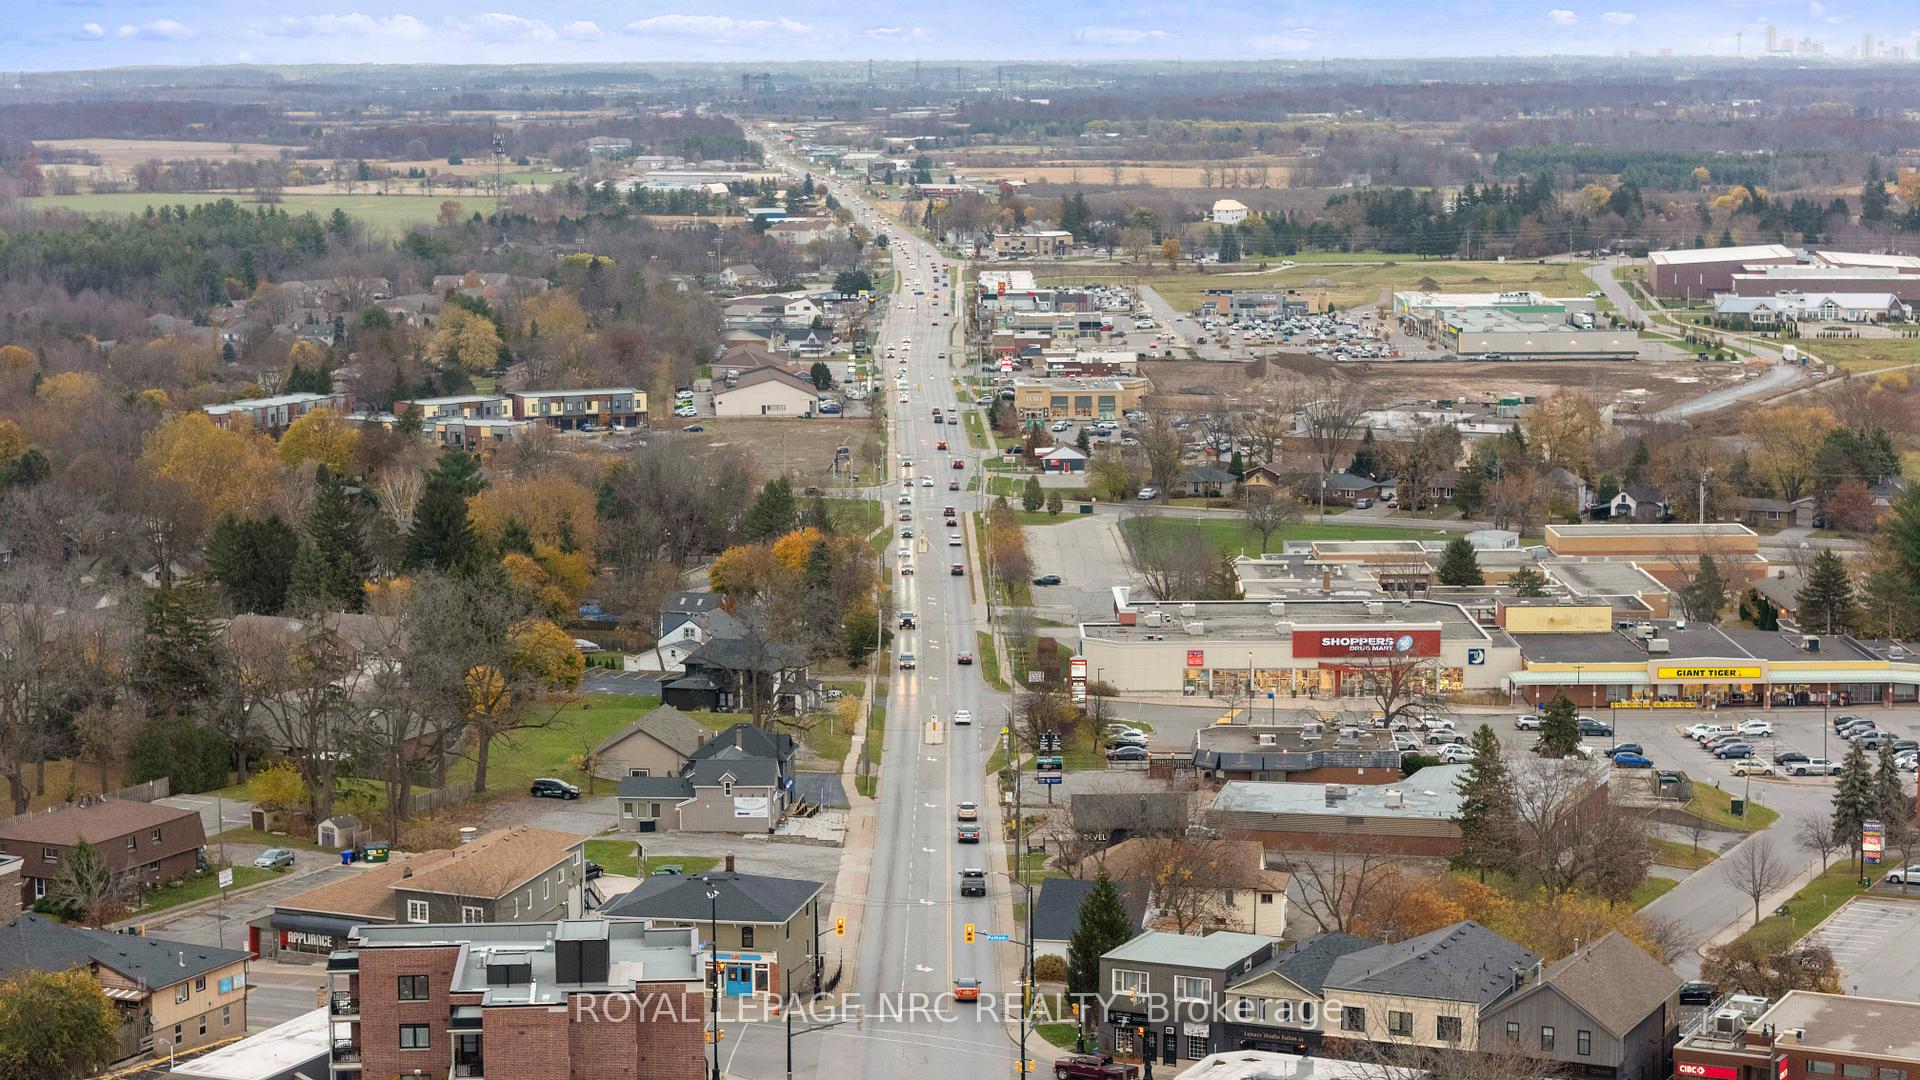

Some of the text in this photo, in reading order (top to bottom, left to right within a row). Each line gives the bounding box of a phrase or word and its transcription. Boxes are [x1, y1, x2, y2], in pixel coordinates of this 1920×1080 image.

[1321, 637, 1394, 646] SHOPPERS
[1676, 669, 1736, 677] GIANT TIGER
[287, 931, 333, 947] APPLIANCE
[1679, 1065, 1697, 1074] CIBC
